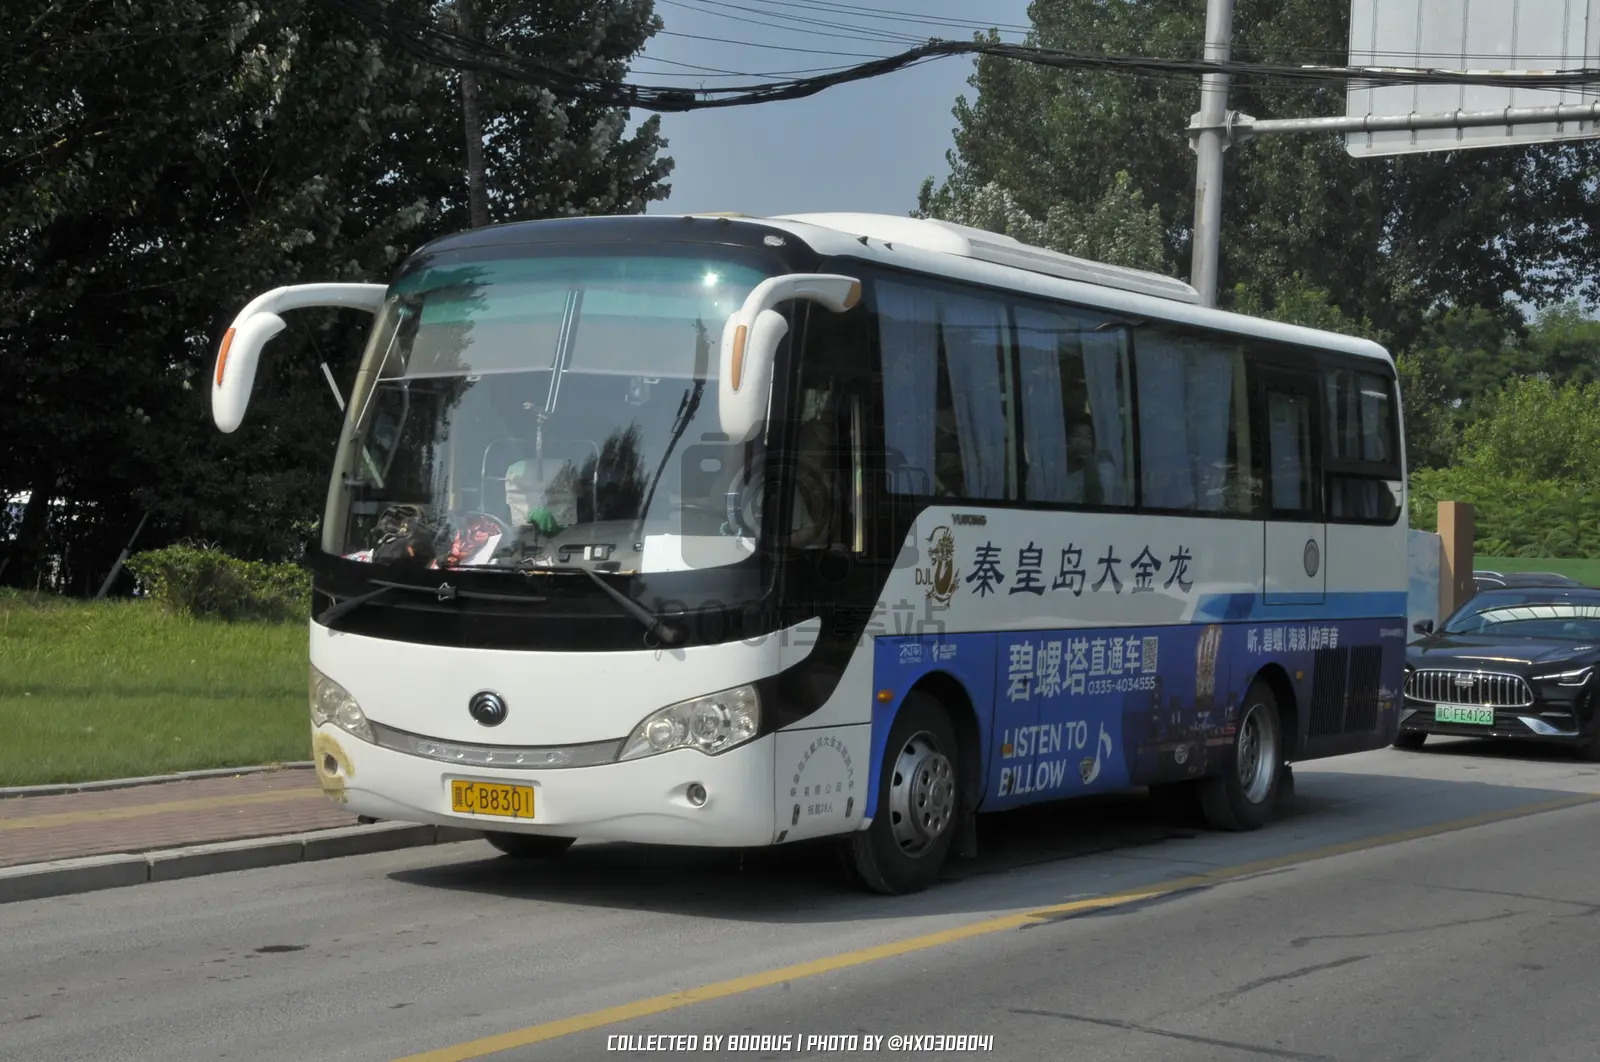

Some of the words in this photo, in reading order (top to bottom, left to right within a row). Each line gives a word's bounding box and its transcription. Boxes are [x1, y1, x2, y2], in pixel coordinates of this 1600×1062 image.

[915, 567, 934, 585] DJL
[965, 541, 1194, 598] 秦皇岛大金龙
[1088, 676, 1156, 695] 0335-4034555
[1002, 723, 1062, 760] LISTEN
[1066, 719, 1087, 750] TO
[997, 758, 1067, 797] BILLOW
